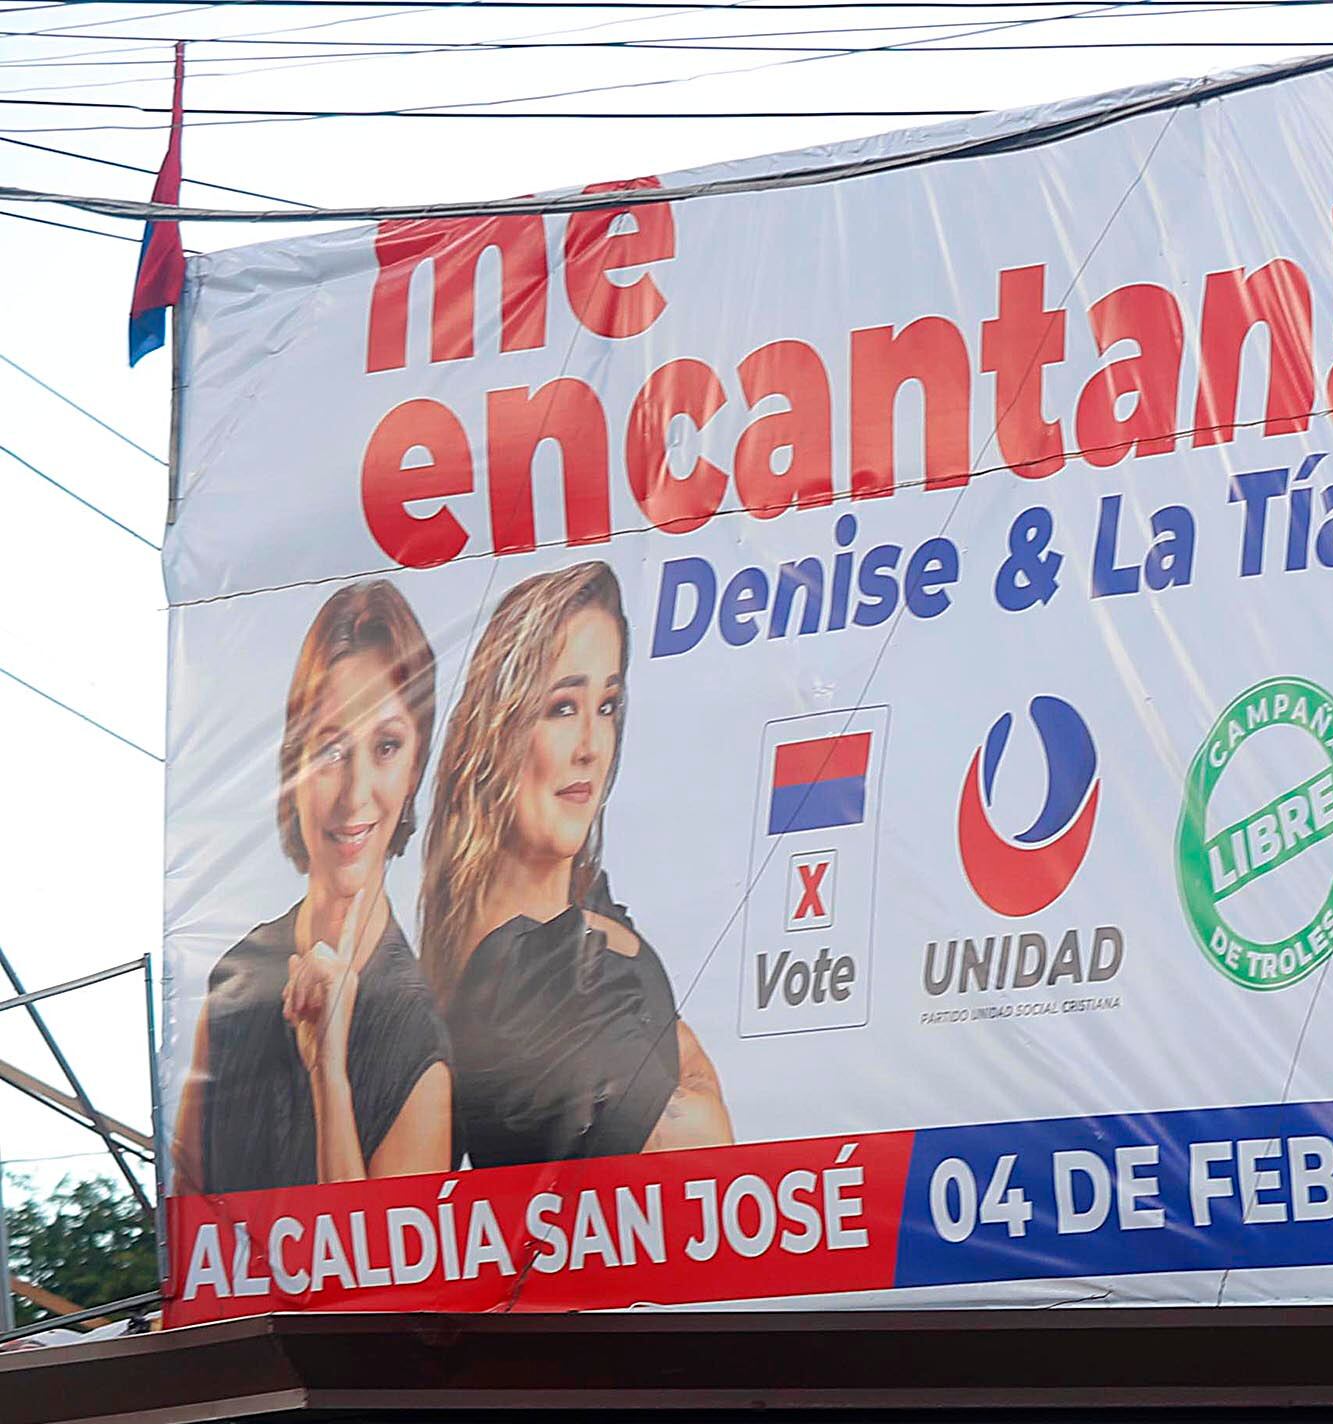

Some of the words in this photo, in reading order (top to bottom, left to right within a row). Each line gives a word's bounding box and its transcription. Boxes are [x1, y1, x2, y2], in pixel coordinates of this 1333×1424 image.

[366, 176, 675, 374] me
[652, 514, 960, 658] Denise
[995, 506, 1064, 612] &
[1091, 494, 1194, 599] La
[757, 948, 855, 1009] Vote
[924, 926, 1123, 996] UNIDAD
[1210, 927, 1243, 970] DE
[184, 1180, 516, 1300] ALCALDÍA
[525, 1183, 667, 1274] SAN
[684, 1143, 869, 1262] JOSÉ
[930, 1154, 1032, 1243] 04
[1053, 1145, 1165, 1234] DE
